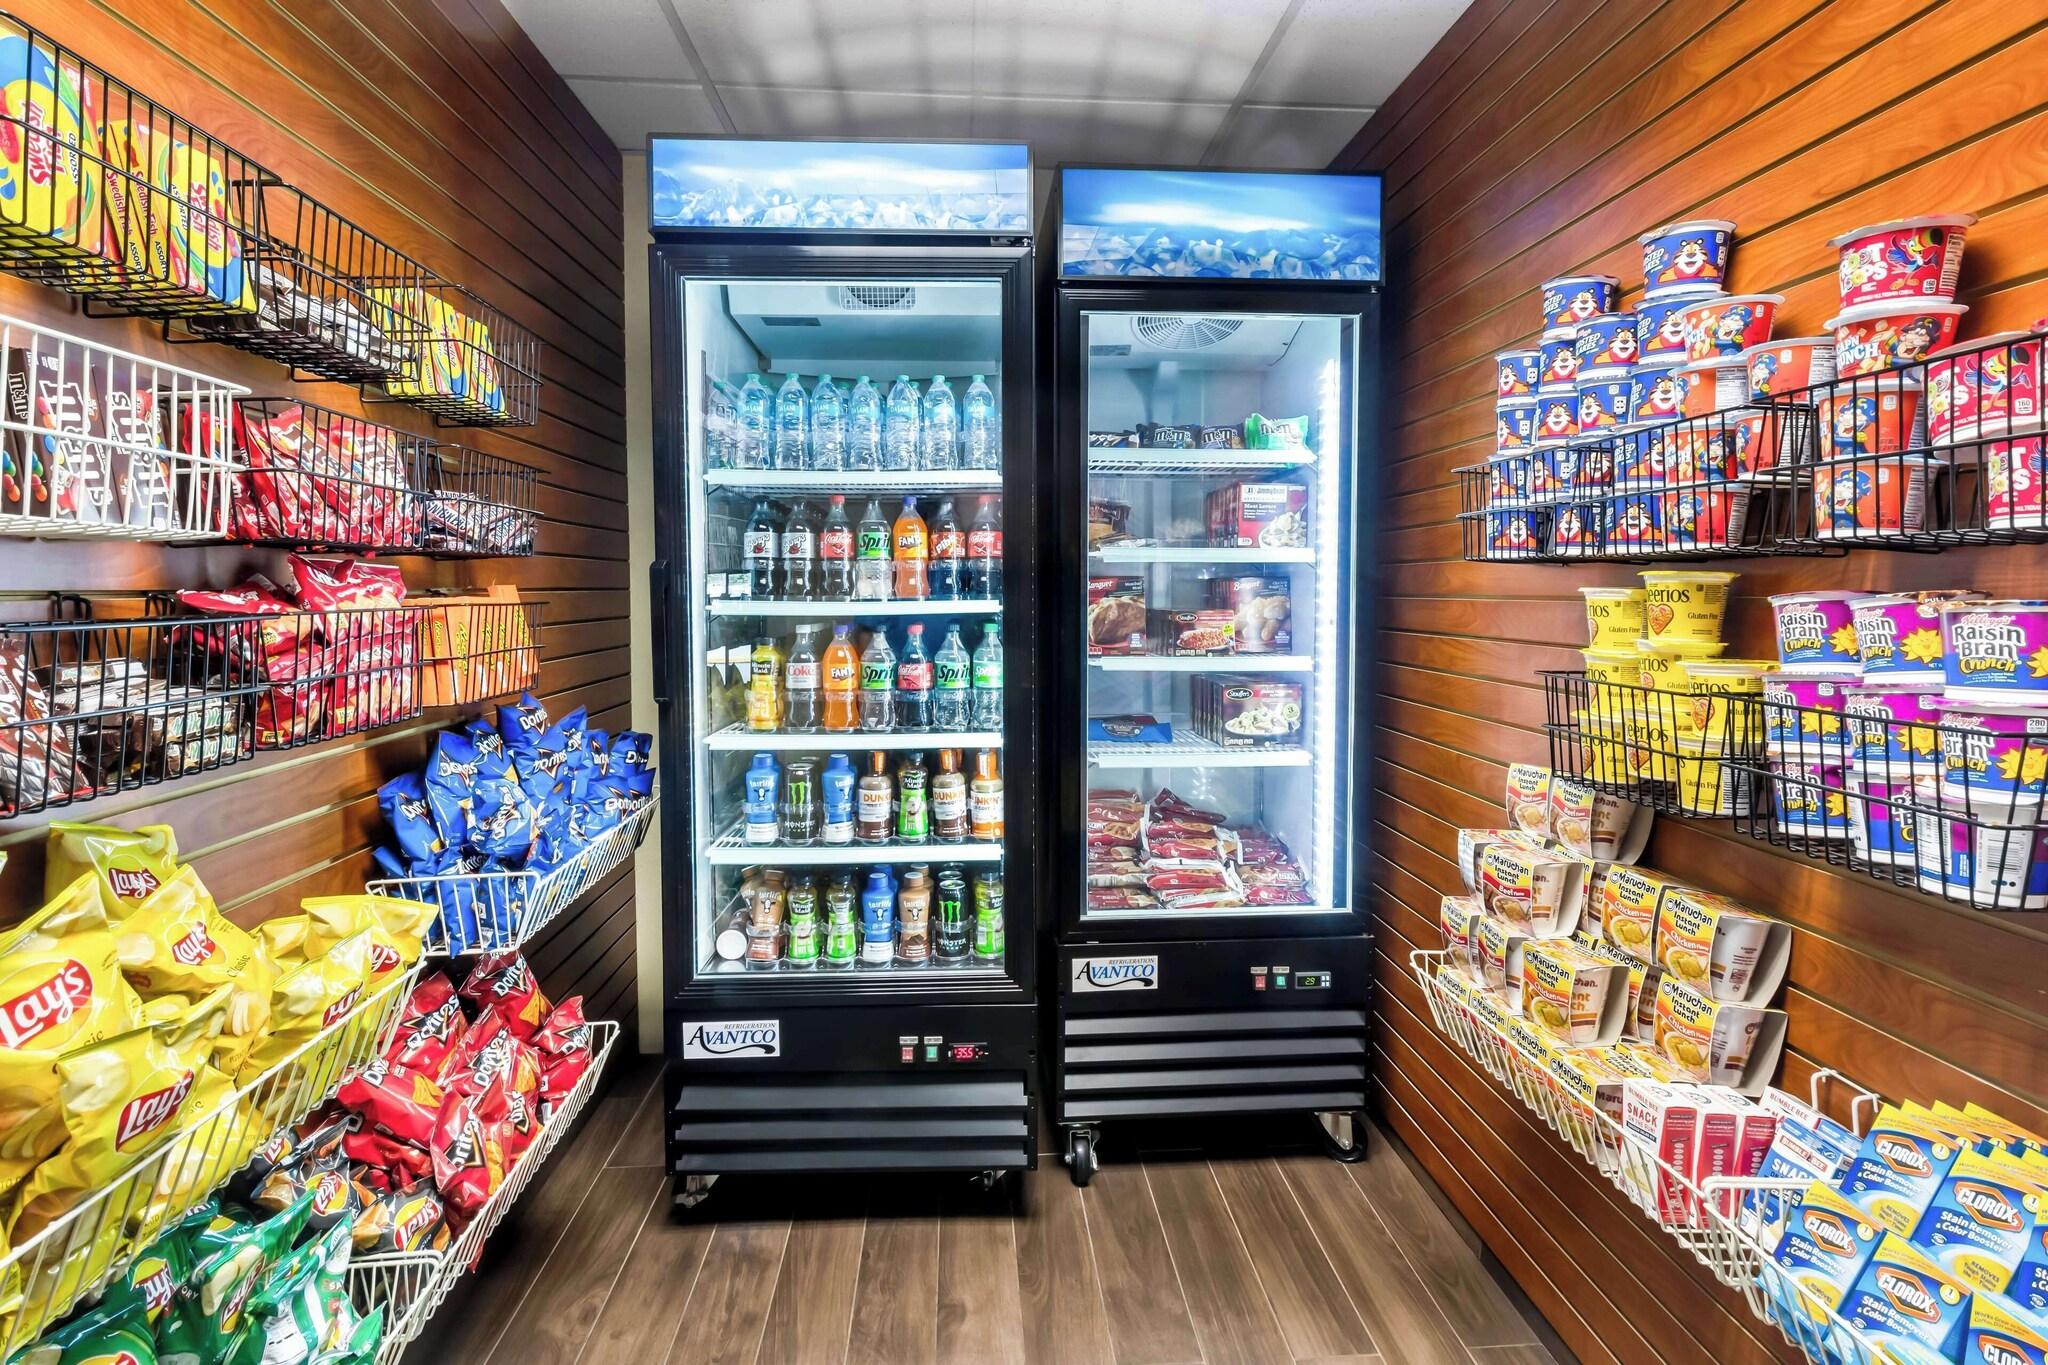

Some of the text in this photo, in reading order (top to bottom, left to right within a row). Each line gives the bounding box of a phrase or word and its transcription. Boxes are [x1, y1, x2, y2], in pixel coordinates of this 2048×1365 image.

[1687, 612, 1708, 620] Gluten
[1779, 613, 1825, 628] Raisin
[1608, 625, 1629, 634] Gluten
[1785, 625, 1819, 641] Bran
[1955, 624, 2023, 644] Raisin
[1784, 638, 1822, 653] Crunch
[1961, 640, 2017, 659] Bran
[788, 665, 813, 675] Coke
[1960, 657, 2016, 674] Crunch
[2028, 719, 2046, 728] 280
[1518, 767, 1547, 780] Maruchan
[1519, 777, 1538, 786] Instant
[1519, 784, 1536, 792] Lunch
[1563, 787, 1583, 801] Instant
[1564, 795, 1580, 806] Lunch
[1493, 853, 1530, 876] Maruchan
[1494, 865, 1520, 880] Instant
[110, 866, 157, 899] Lay's
[1497, 872, 1517, 886] Lunch
[1617, 870, 1657, 896] Maruchan
[1617, 881, 1645, 900] Instant
[1619, 889, 1641, 906] Lunch
[1614, 900, 1640, 917] Chicken
[1673, 898, 1713, 927] Maruchan
[1673, 910, 1702, 931] Instant
[1675, 919, 1697, 938] Lunch
[173, 920, 213, 966] Lay's
[1669, 930, 1697, 950] Chicken
[1532, 952, 1570, 980] Maruchan
[1606, 945, 1644, 973] Maruchan
[493, 959, 528, 997] Doritos
[1074, 960, 1155, 982] AVANTCO
[1304, 976, 1315, 985] 29
[1534, 964, 1559, 983] Instant
[1536, 973, 1556, 989] Lunch
[0, 966, 86, 1050] Lay's
[1670, 996, 1700, 1020] Instant
[1671, 983, 1713, 1017] Maruchan
[406, 994, 461, 1050] Doritos
[1476, 999, 1506, 1028] Maruchan
[1672, 1006, 1697, 1026] Lunch
[723, 1023, 777, 1031] REFRIGERATION
[1667, 1014, 1697, 1038] Chicken
[686, 1025, 777, 1049] AVANTCO
[1515, 1026, 1549, 1059] Maruchan
[1556, 1060, 1593, 1096] Maruchan
[118, 1074, 194, 1145] Lay's
[1626, 1101, 1659, 1128] SNACK
[1861, 1160, 1921, 1194] Stain Remover
[1864, 1170, 1885, 1187] Color
[1885, 1178, 1916, 1197] Booster
[1940, 1211, 2013, 1251] Stain Remover
[1942, 1221, 1967, 1241] Color
[1967, 1230, 2004, 1254] Booster
[1790, 1236, 1846, 1271] Stain Remover
[1791, 1246, 1812, 1264] Color
[1812, 1255, 1840, 1276] Booster
[1971, 1260, 2001, 1283] REMOVES
[1861, 1295, 1929, 1341] Stain Remover
[1863, 1306, 1883, 1324] Color
